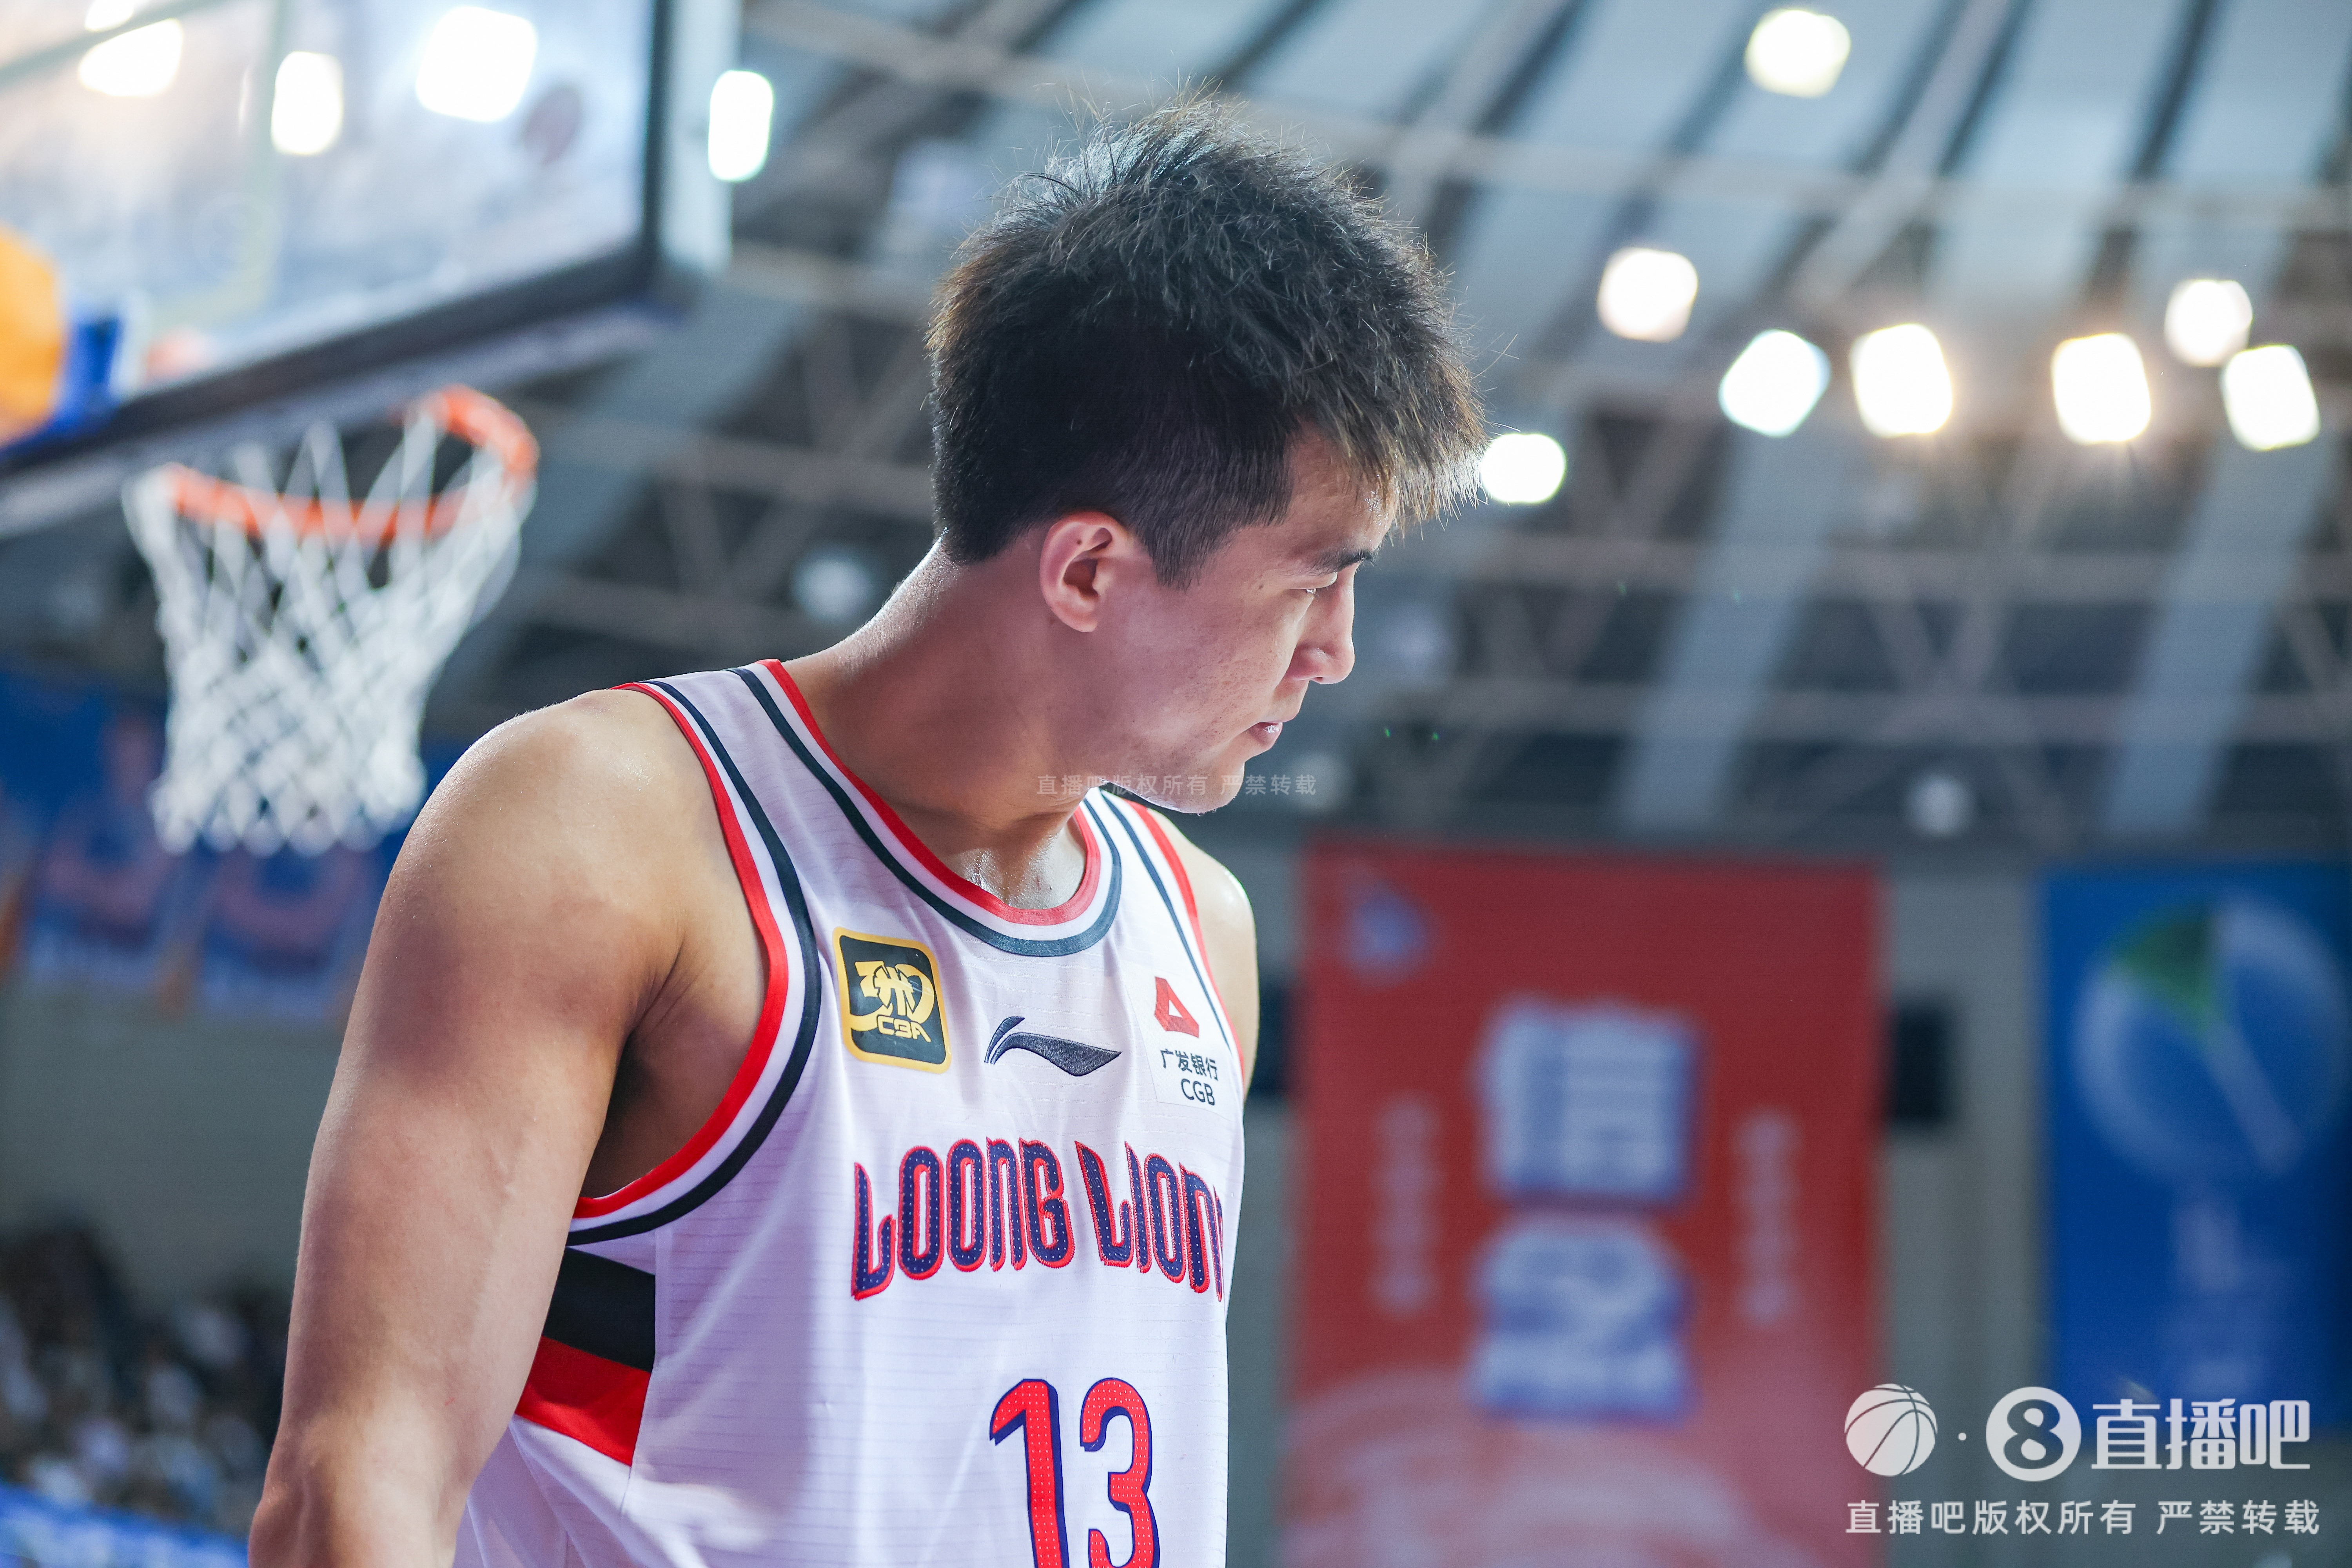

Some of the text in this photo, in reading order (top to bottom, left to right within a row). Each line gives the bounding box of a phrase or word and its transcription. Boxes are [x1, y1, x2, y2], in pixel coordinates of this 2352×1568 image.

[877, 1014, 931, 1042] CBA
[1160, 1048, 1218, 1081] 广发银行
[1181, 1078, 1215, 1106] CGB
[851, 1136, 1076, 1301] LOONG
[1074, 1140, 1224, 1302] LION
[989, 1377, 1160, 1568] 13
